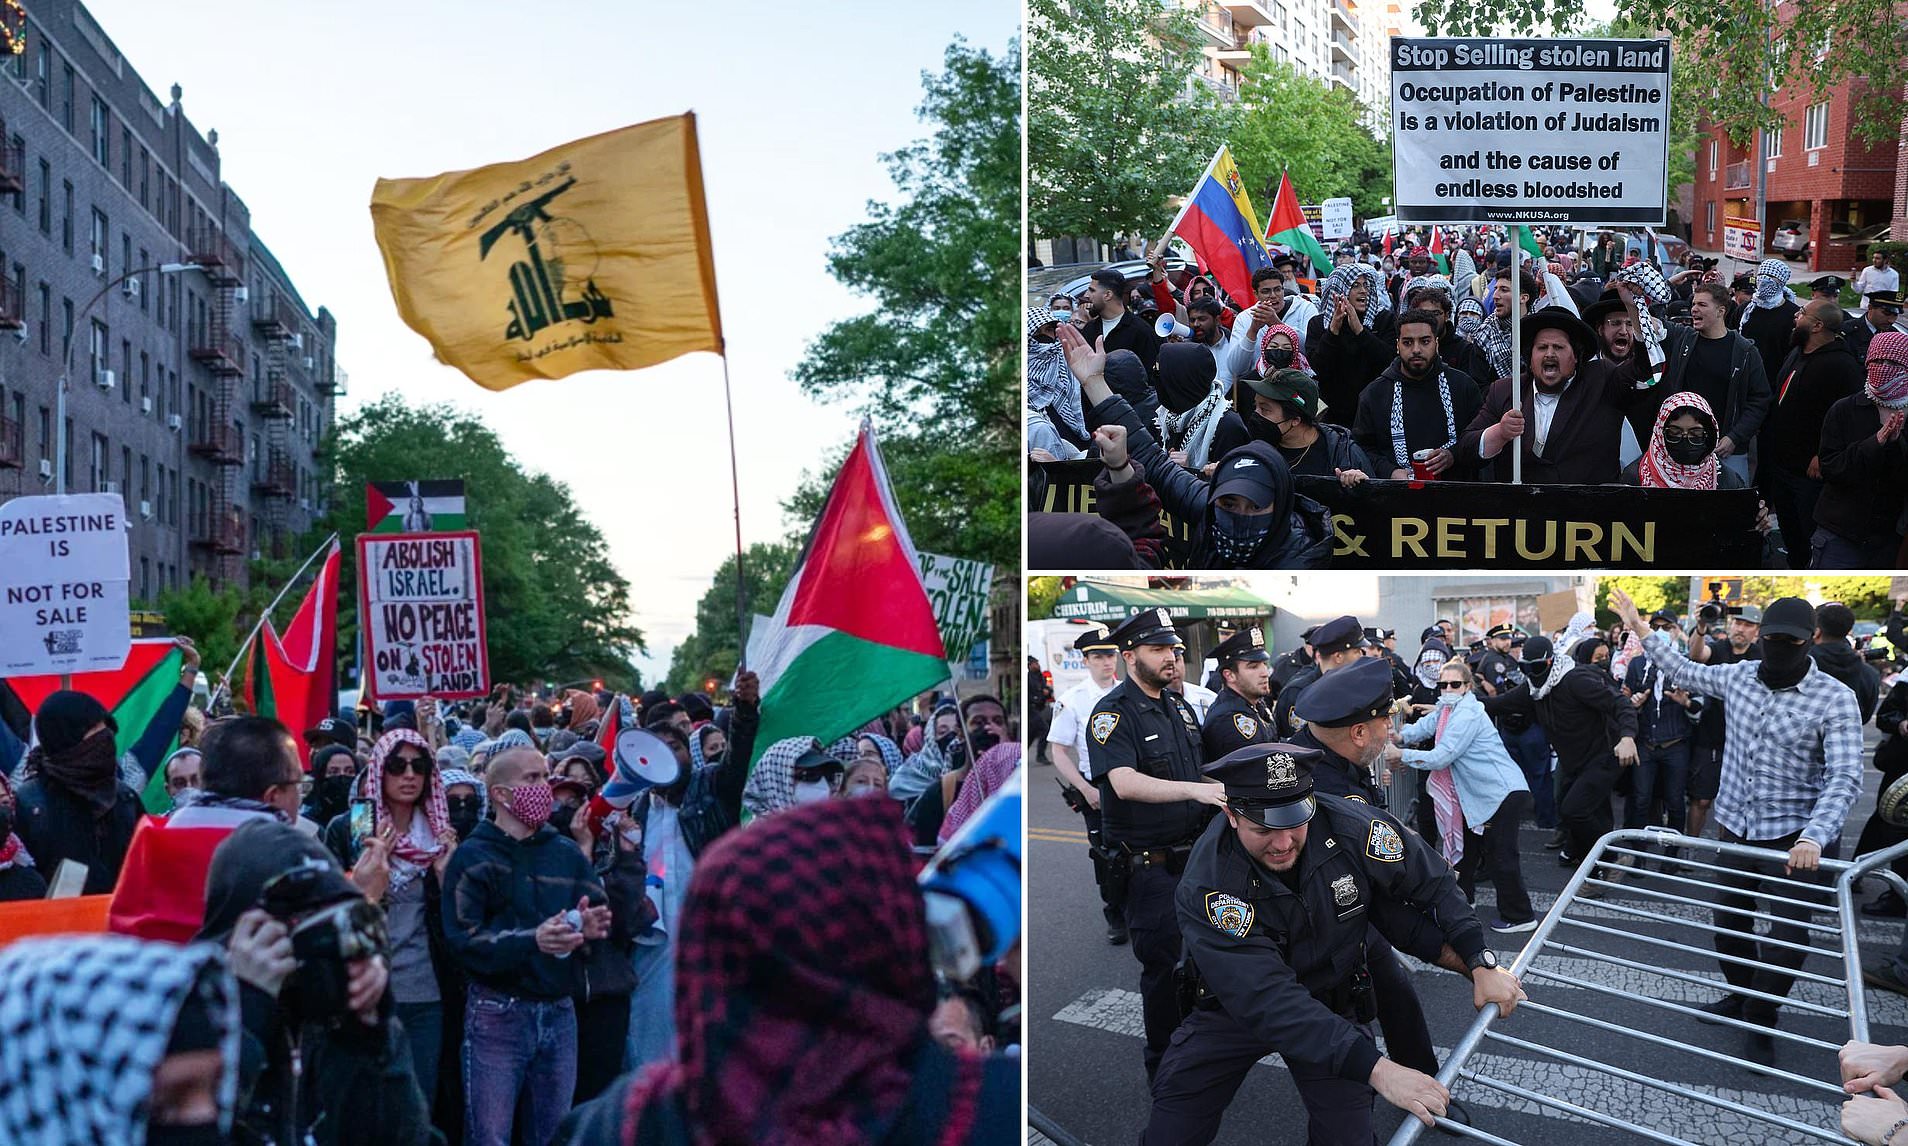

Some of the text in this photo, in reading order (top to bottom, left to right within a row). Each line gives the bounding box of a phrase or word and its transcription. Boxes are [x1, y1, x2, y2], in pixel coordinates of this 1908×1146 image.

[1397, 44, 1663, 69] Stop Selling stolen land
[1399, 81, 1662, 105] Occupation of Palestine
[1400, 111, 1660, 132] is a violation of Judaism
[1440, 151, 1620, 171] and the cause of
[1435, 179, 1623, 199] endless bloodshed
[1487, 211, 1569, 221] www.NKUSA.org
[1, 514, 116, 536] PALESTINE
[51, 540, 70, 557] IS
[1330, 514, 1656, 562] & RETURN
[383, 541, 456, 569] ABOLISH
[389, 570, 460, 596] ISRAEL.
[947, 559, 991, 598] SALE
[8, 582, 104, 604] NOT FOR
[36, 606, 87, 626] SALE
[1054, 601, 1108, 617] CHIKURIN
[382, 603, 476, 643] NO PEACE
[377, 642, 478, 675] ON STOLEN
